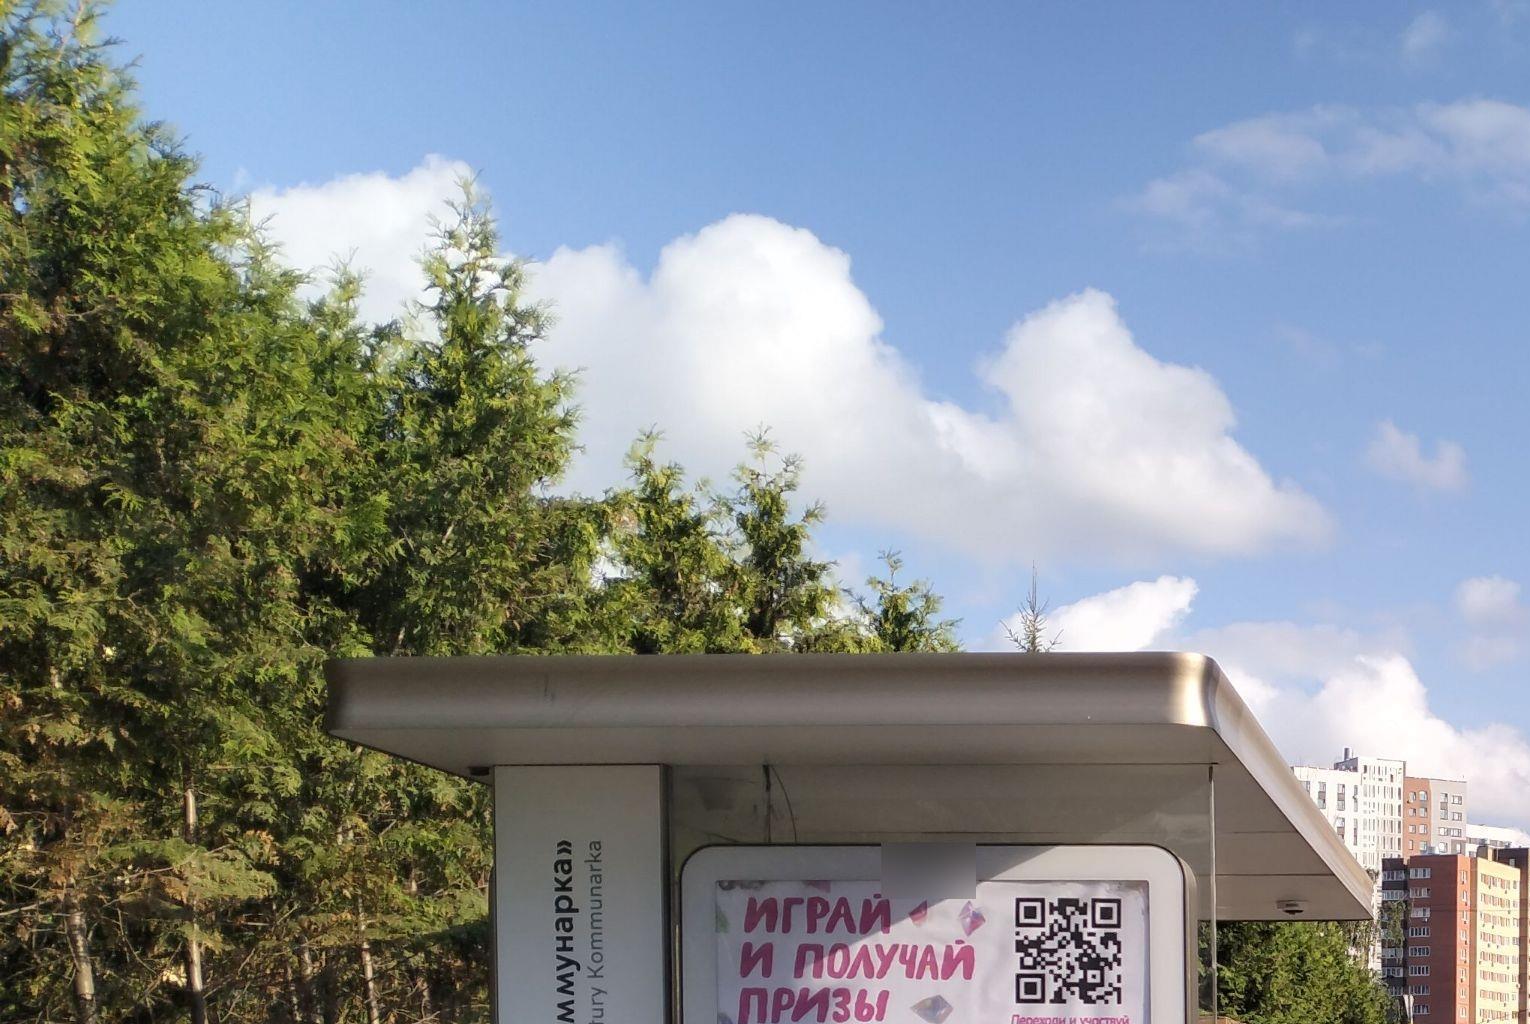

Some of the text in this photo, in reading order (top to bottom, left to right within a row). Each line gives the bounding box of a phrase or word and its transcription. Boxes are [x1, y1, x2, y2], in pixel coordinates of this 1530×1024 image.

[584, 839, 605, 979] Kommunarka
[743, 893, 891, 935] ИГРАЙ
[740, 939, 977, 981] И ПОЛУЧАЙ
